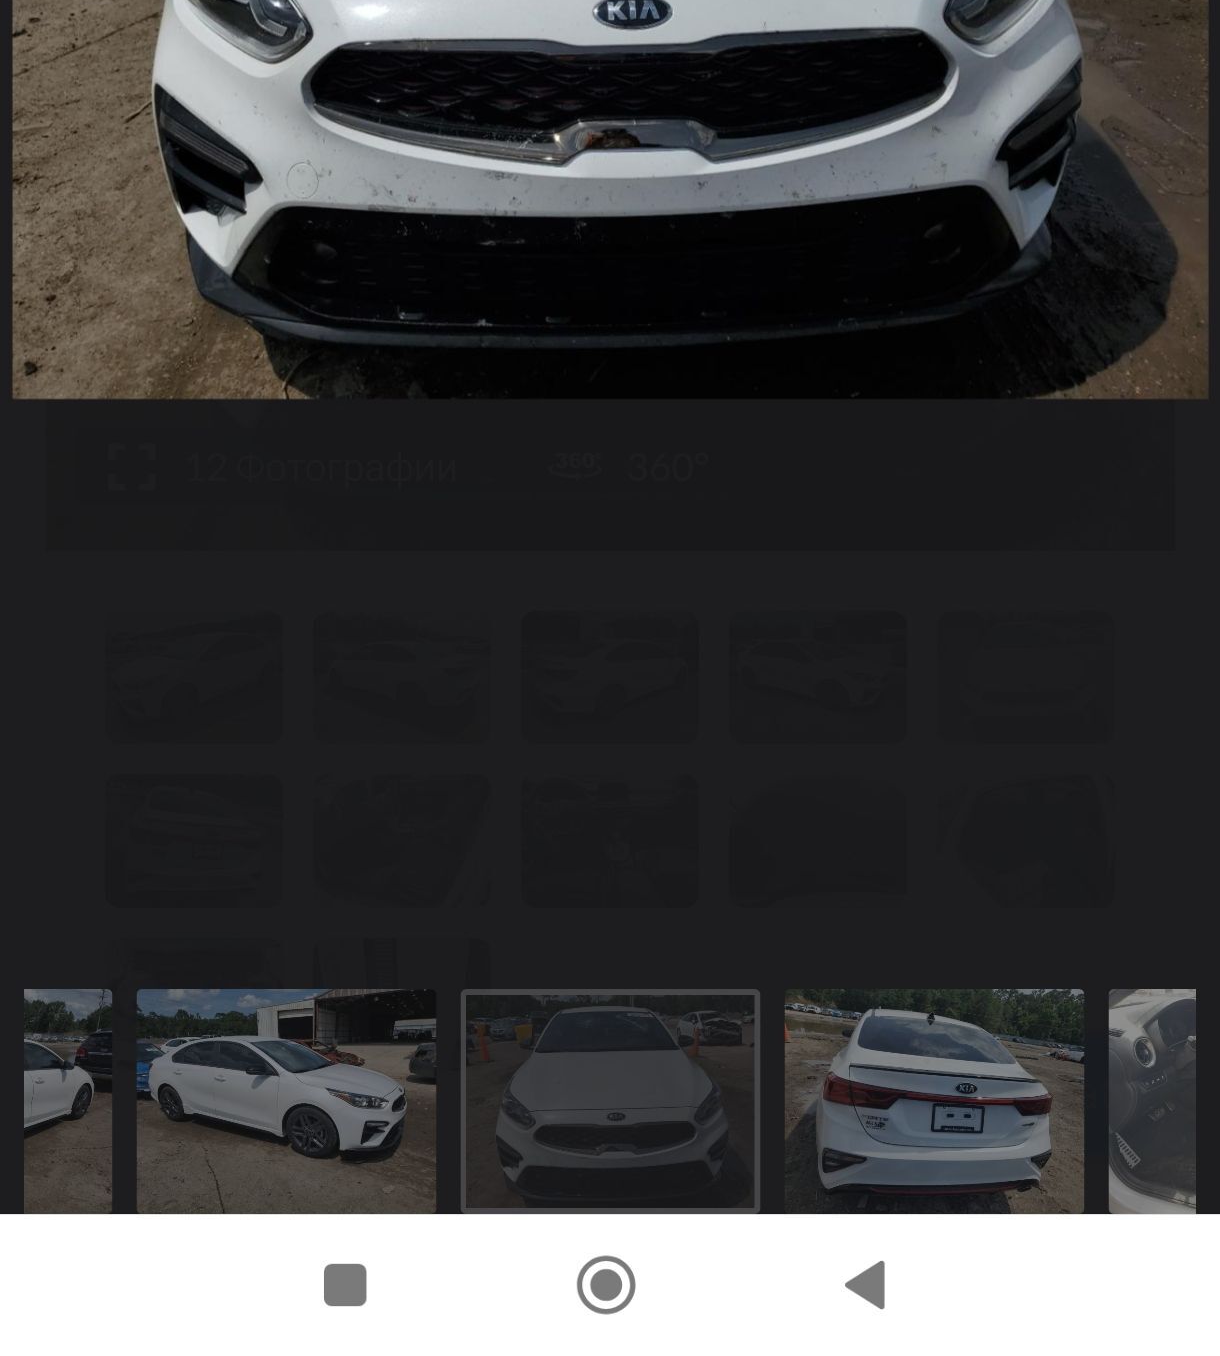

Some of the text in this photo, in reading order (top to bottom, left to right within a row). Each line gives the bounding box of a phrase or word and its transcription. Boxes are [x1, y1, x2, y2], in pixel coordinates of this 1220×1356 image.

[606, 0, 660, 21] KIA
[187, 451, 457, 490] 12 Фотографии
[627, 451, 710, 483] 360°
